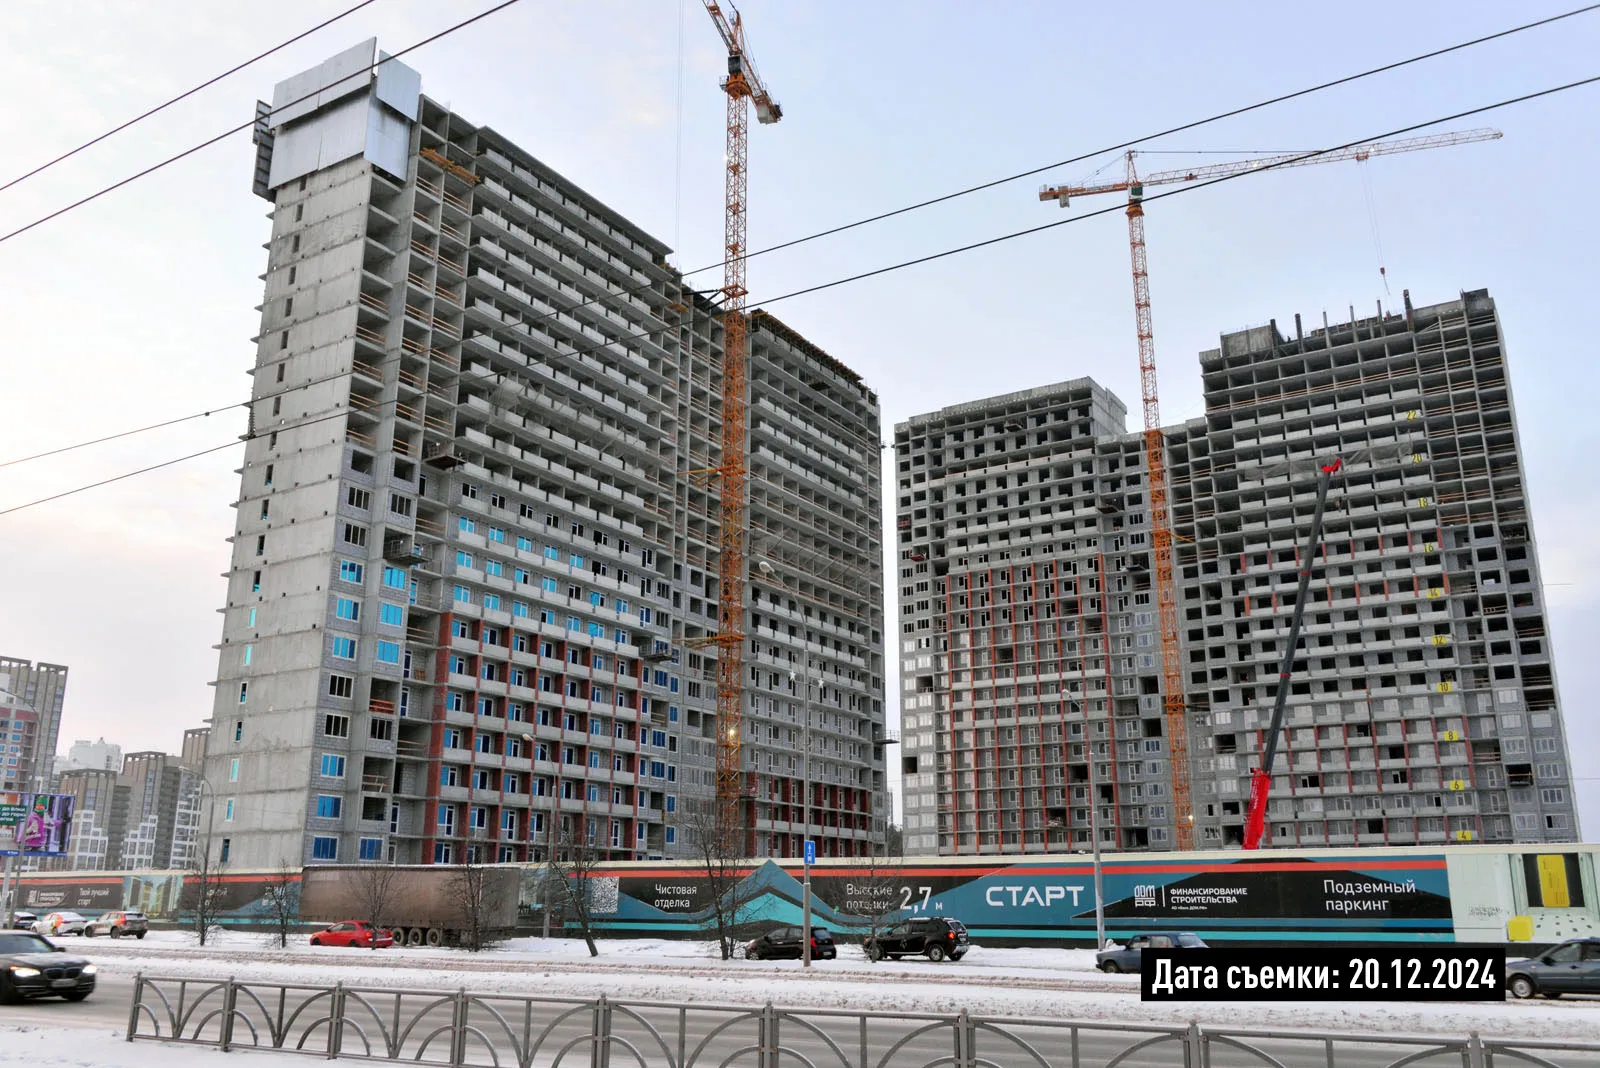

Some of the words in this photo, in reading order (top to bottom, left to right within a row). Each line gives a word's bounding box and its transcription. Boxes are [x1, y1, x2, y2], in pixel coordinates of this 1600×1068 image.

[655, 883, 697, 895] Чистовая
[1170, 887, 1248, 895] ФИНАНСИРОВАНИЕ
[1324, 879, 1416, 895] Подземный
[899, 886, 932, 913] 2,7
[935, 902, 943, 910] м
[985, 886, 1085, 907] СТАРТ
[1170, 896, 1238, 904] СТРОИТЕЛЬСТВА
[654, 899, 690, 909] отделка
[1325, 898, 1390, 915] паркинг
